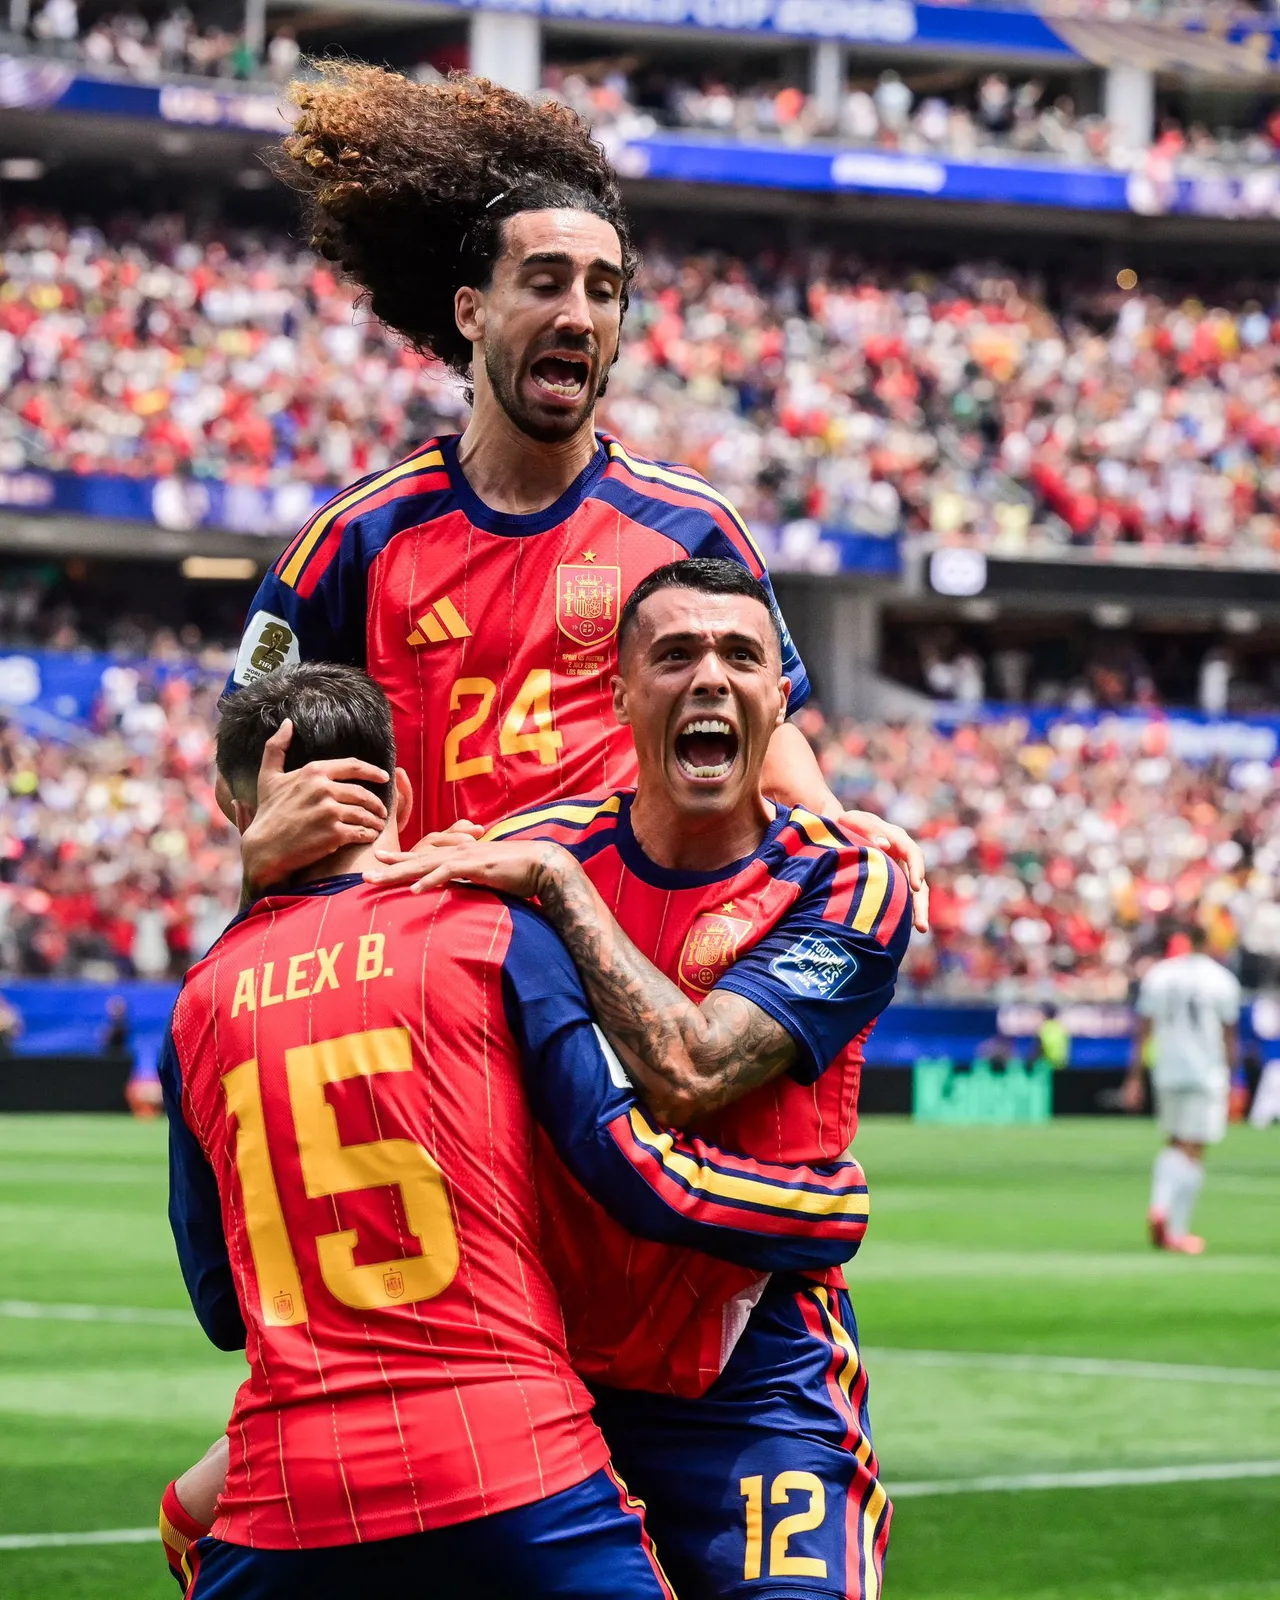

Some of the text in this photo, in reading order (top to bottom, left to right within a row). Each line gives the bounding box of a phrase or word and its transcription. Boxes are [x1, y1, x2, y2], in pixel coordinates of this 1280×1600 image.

[258, 659, 273, 670] FIFA
[444, 668, 563, 782] 24
[231, 932, 394, 1019] ALEX B.
[804, 948, 839, 984] UNITES
[811, 939, 848, 975] FOOTBALL
[220, 1026, 460, 1327] 15
[740, 1470, 827, 1580] 12
